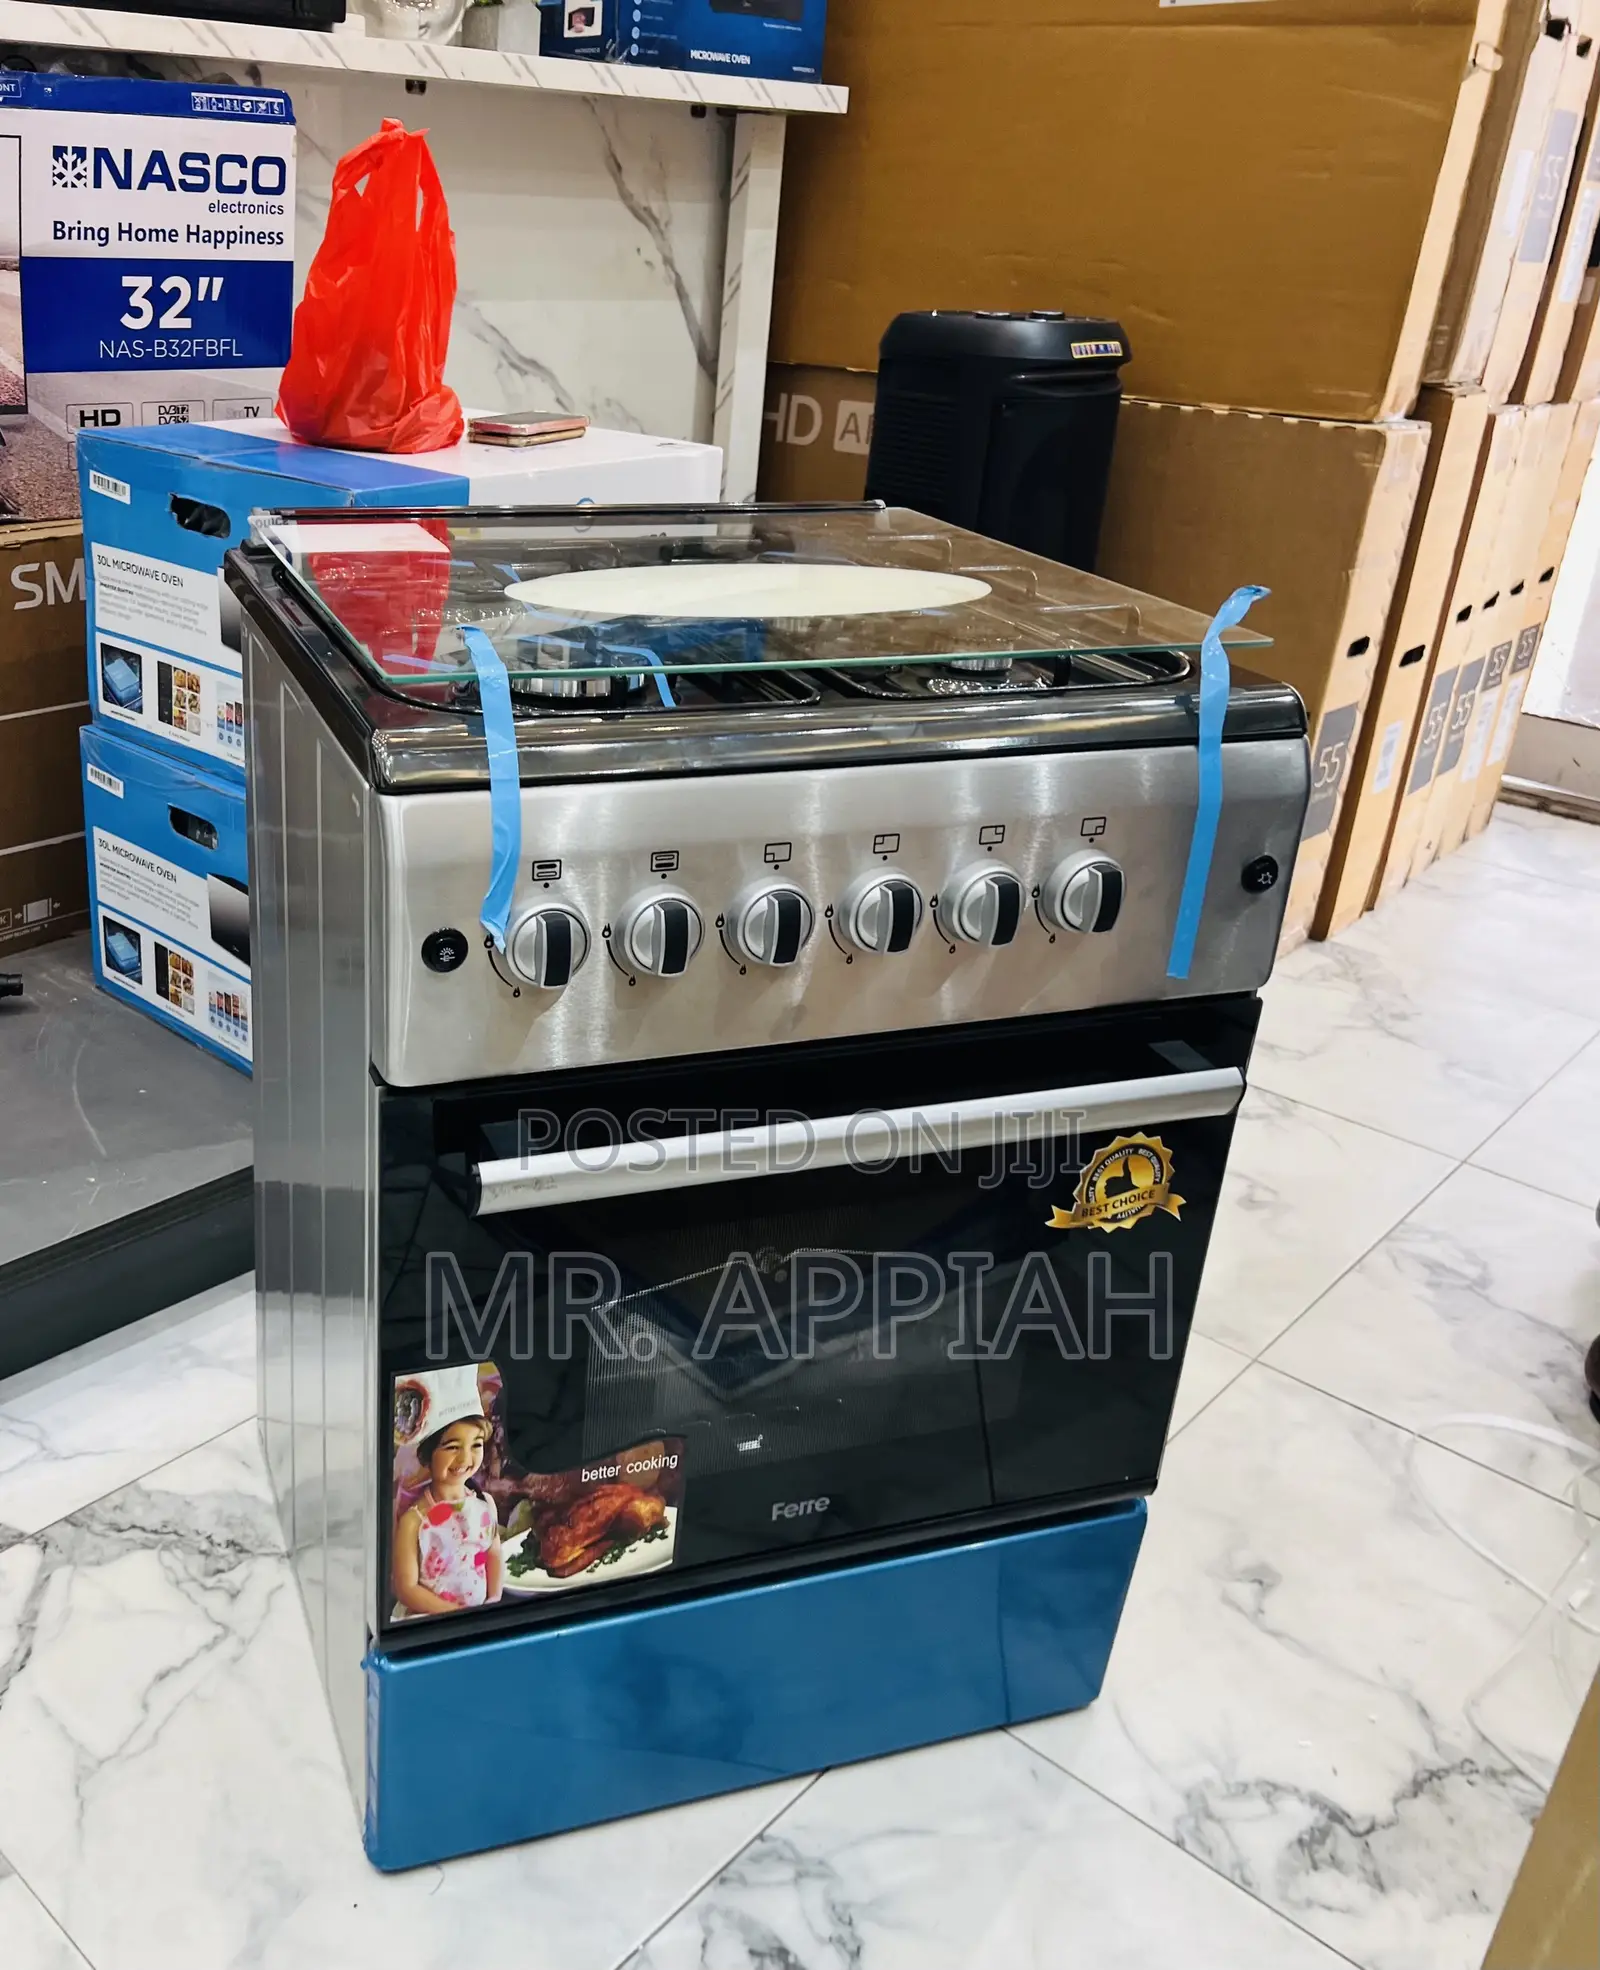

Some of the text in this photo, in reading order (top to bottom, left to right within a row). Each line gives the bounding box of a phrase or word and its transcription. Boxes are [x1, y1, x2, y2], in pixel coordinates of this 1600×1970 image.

[690, 49, 750, 65] MICROWAVE OVEN
[93, 147, 287, 196] NASCO
[208, 199, 285, 215] electronics
[53, 220, 285, 250] Bring Home Happiness
[99, 338, 243, 359] NAS-B32FBFL
[79, 408, 121, 428] HD
[96, 554, 184, 588] 30L MICROWAVE OVEN
[1314, 741, 1346, 788] 55
[112, 844, 156, 873] MICROWAVE
[156, 866, 177, 883] OVEN
[1092, 1148, 1134, 1182] BEST QUALITY
[1081, 1189, 1156, 1218] BEST CHOICE
[581, 1454, 679, 1483] better cooking
[771, 1496, 831, 1521] Ferre
